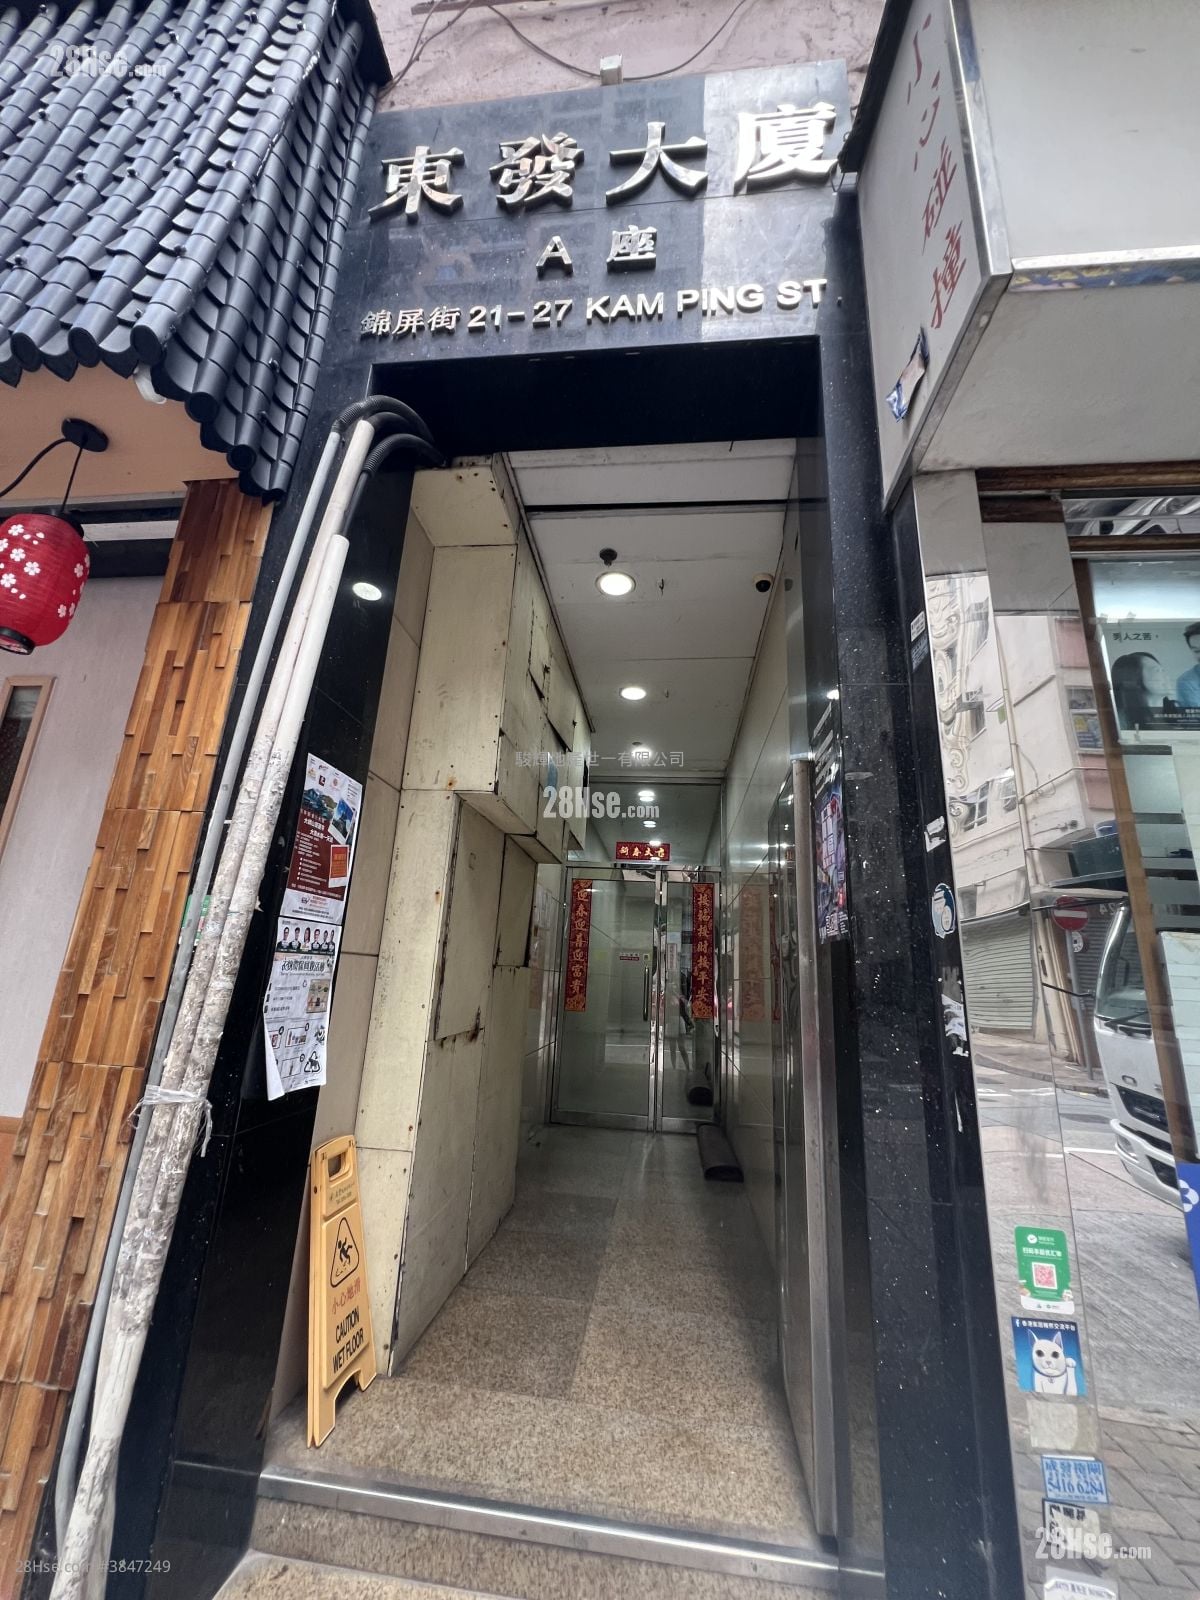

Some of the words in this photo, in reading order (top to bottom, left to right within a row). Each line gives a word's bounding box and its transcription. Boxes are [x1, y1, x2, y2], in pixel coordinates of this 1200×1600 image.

[368, 101, 839, 222] 東發大廈
[906, 12, 969, 330] 小心碰撞
[536, 235, 573, 276] A
[607, 224, 657, 271] 座
[361, 306, 461, 338] 錦屏街
[586, 291, 665, 325] KAM
[677, 282, 764, 318] PING
[619, 846, 665, 858] 新春大吉
[336, 1305, 360, 1344] CAUTION
[333, 1346, 345, 1374] WET
[346, 1328, 364, 1361] FLOOR
